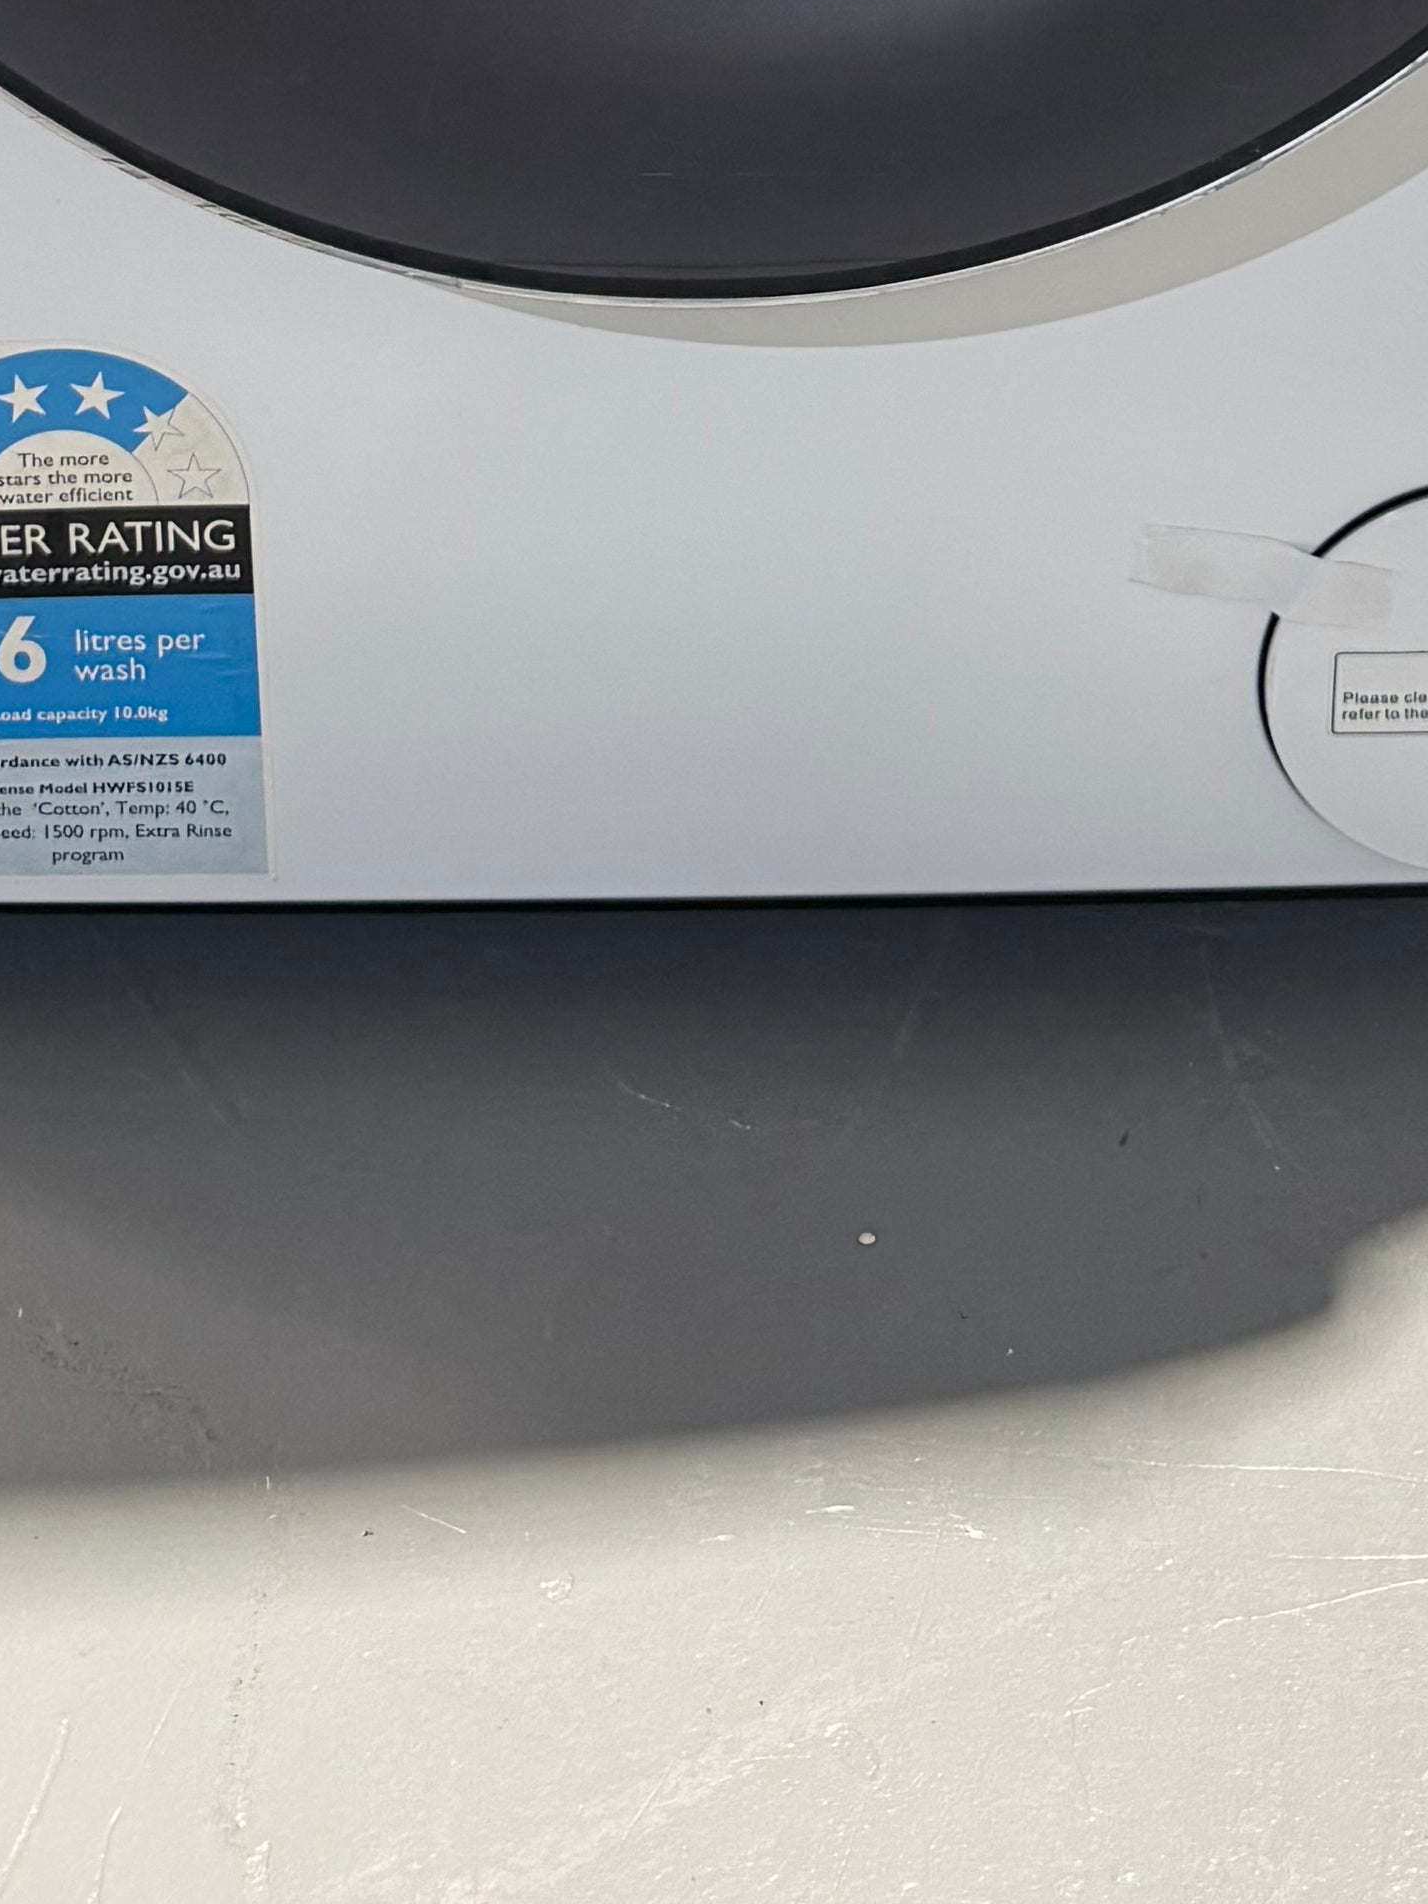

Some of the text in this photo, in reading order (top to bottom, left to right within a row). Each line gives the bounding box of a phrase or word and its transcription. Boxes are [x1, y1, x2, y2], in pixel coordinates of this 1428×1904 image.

[17, 452, 109, 467] The more
[48, 470, 77, 484] the
[84, 472, 133, 484] more
[0, 487, 133, 504] water efficient
[67, 519, 236, 556] RATING
[73, 627, 205, 656] litres per
[74, 656, 146, 682] wash
[1342, 691, 1398, 704] Please
[37, 706, 109, 725] capacity
[113, 704, 169, 724] 10.0kg
[1342, 708, 1381, 721] refer
[1384, 708, 1401, 720] to
[65, 754, 104, 768] with
[107, 753, 180, 767] AS/NZS
[185, 752, 227, 766] 6400
[39, 782, 88, 794] Model
[115, 800, 171, 819] Temp:
[175, 799, 197, 815] 40
[43, 825, 84, 839] 1500
[135, 823, 181, 839] Extra
[186, 822, 233, 838] Rinse
[51, 849, 125, 865] program
